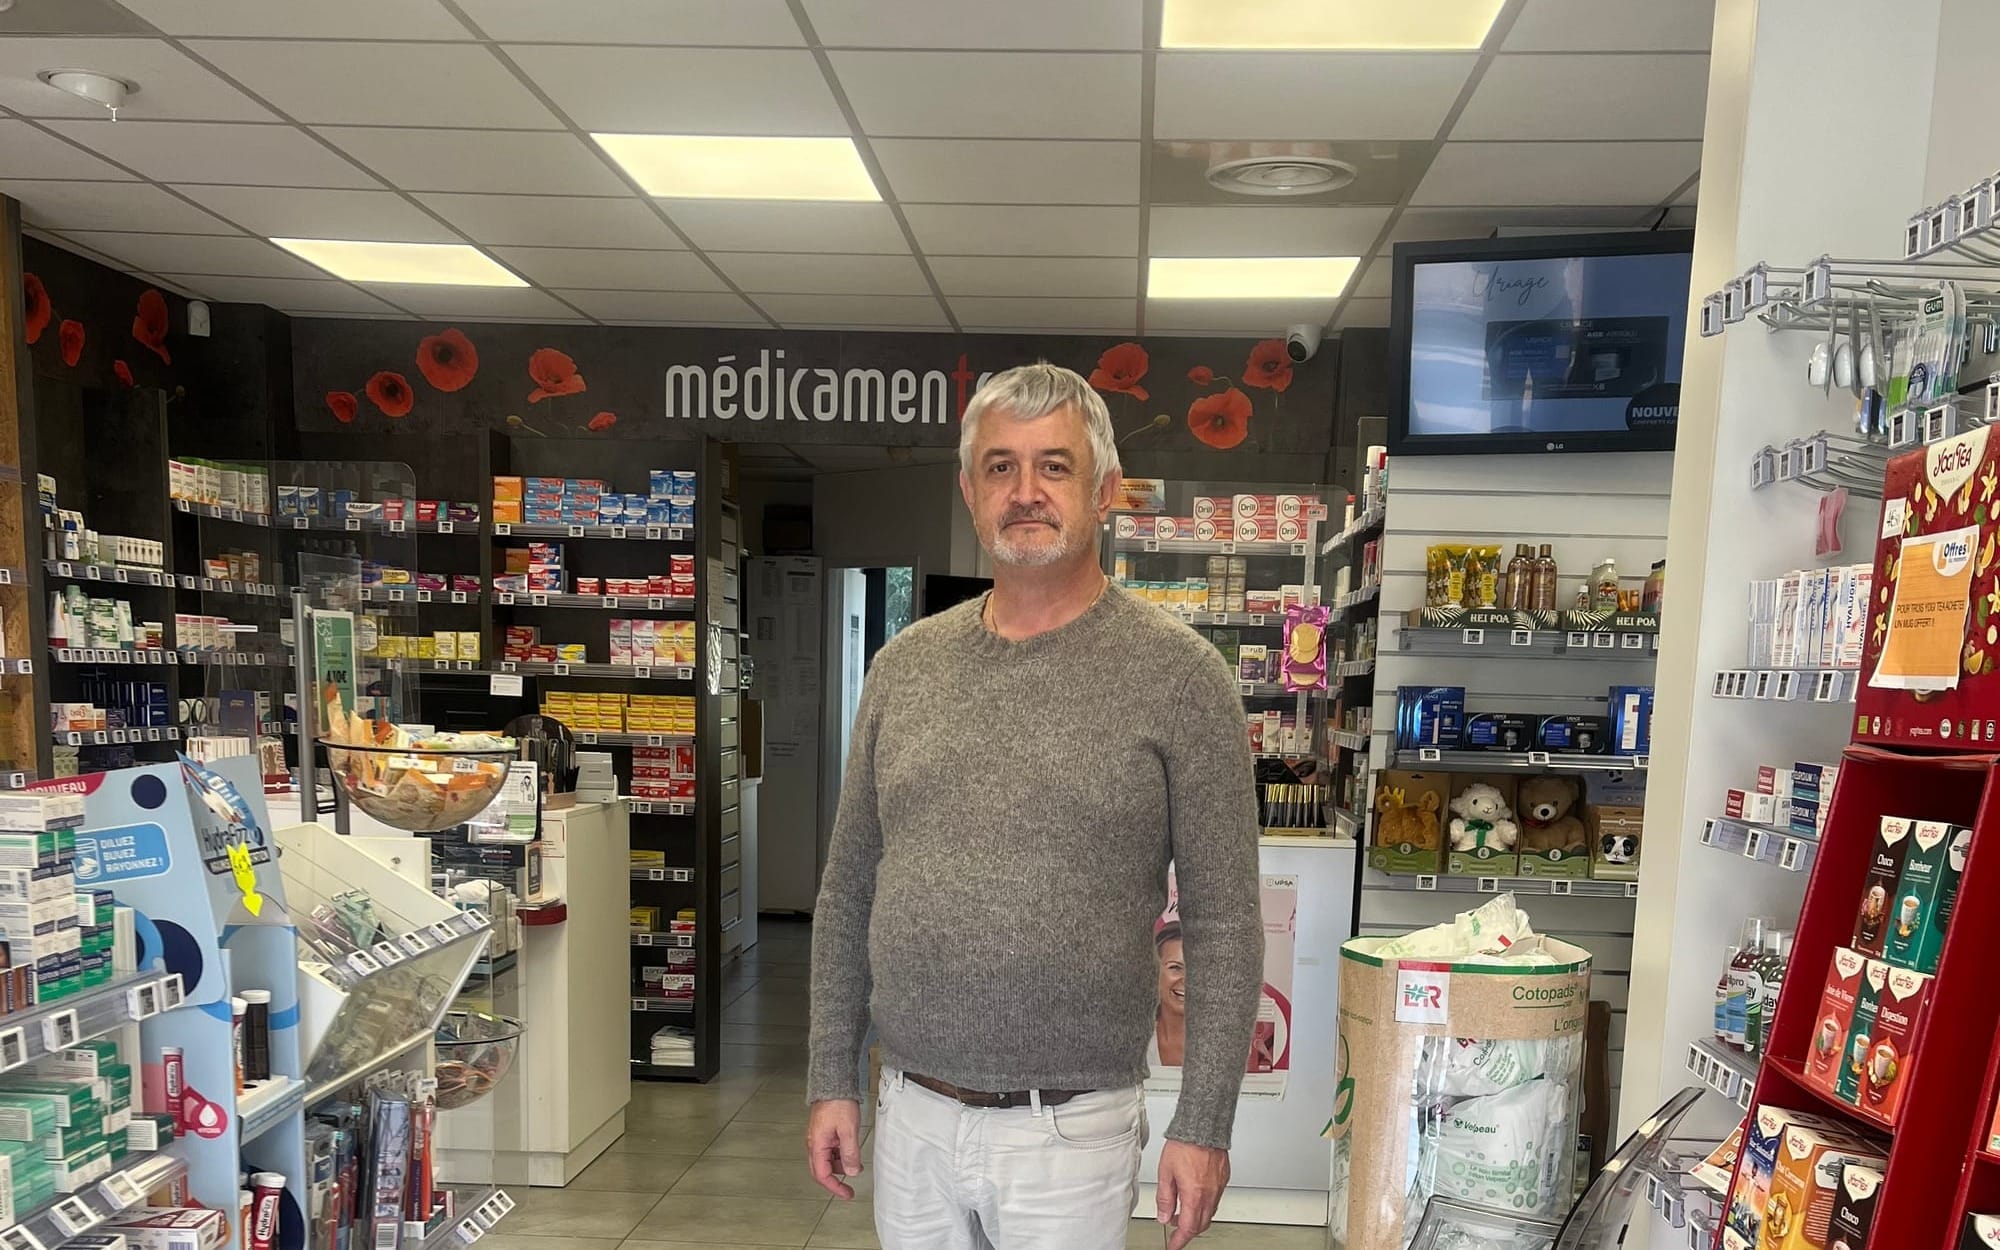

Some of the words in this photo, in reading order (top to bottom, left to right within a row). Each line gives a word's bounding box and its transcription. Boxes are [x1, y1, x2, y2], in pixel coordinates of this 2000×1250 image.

[1473, 266, 1549, 305] Uriage
[665, 348, 993, 424] médicament
[1956, 442, 1973, 470] TEA
[1120, 524, 1135, 532] Drill
[1160, 525, 1175, 533] Drill
[1198, 527, 1213, 535] Drill
[1944, 542, 1967, 558] Offres
[1470, 614, 1488, 623] HEI
[1490, 615, 1510, 624] POA
[1616, 617, 1634, 626] HEI
[1636, 618, 1656, 627] POA
[1903, 619, 1914, 628] MUG
[100, 836, 135, 849] DILUEZ
[102, 849, 136, 861] BUVEZ
[1877, 853, 1894, 867] Choco
[105, 858, 158, 873] RAYONNEZ
[1909, 859, 1933, 873] Bonheur
[1881, 1006, 1908, 1025] Digestion
[1464, 1121, 1496, 1134] Velpeau
[1841, 1206, 1859, 1226] Choco
